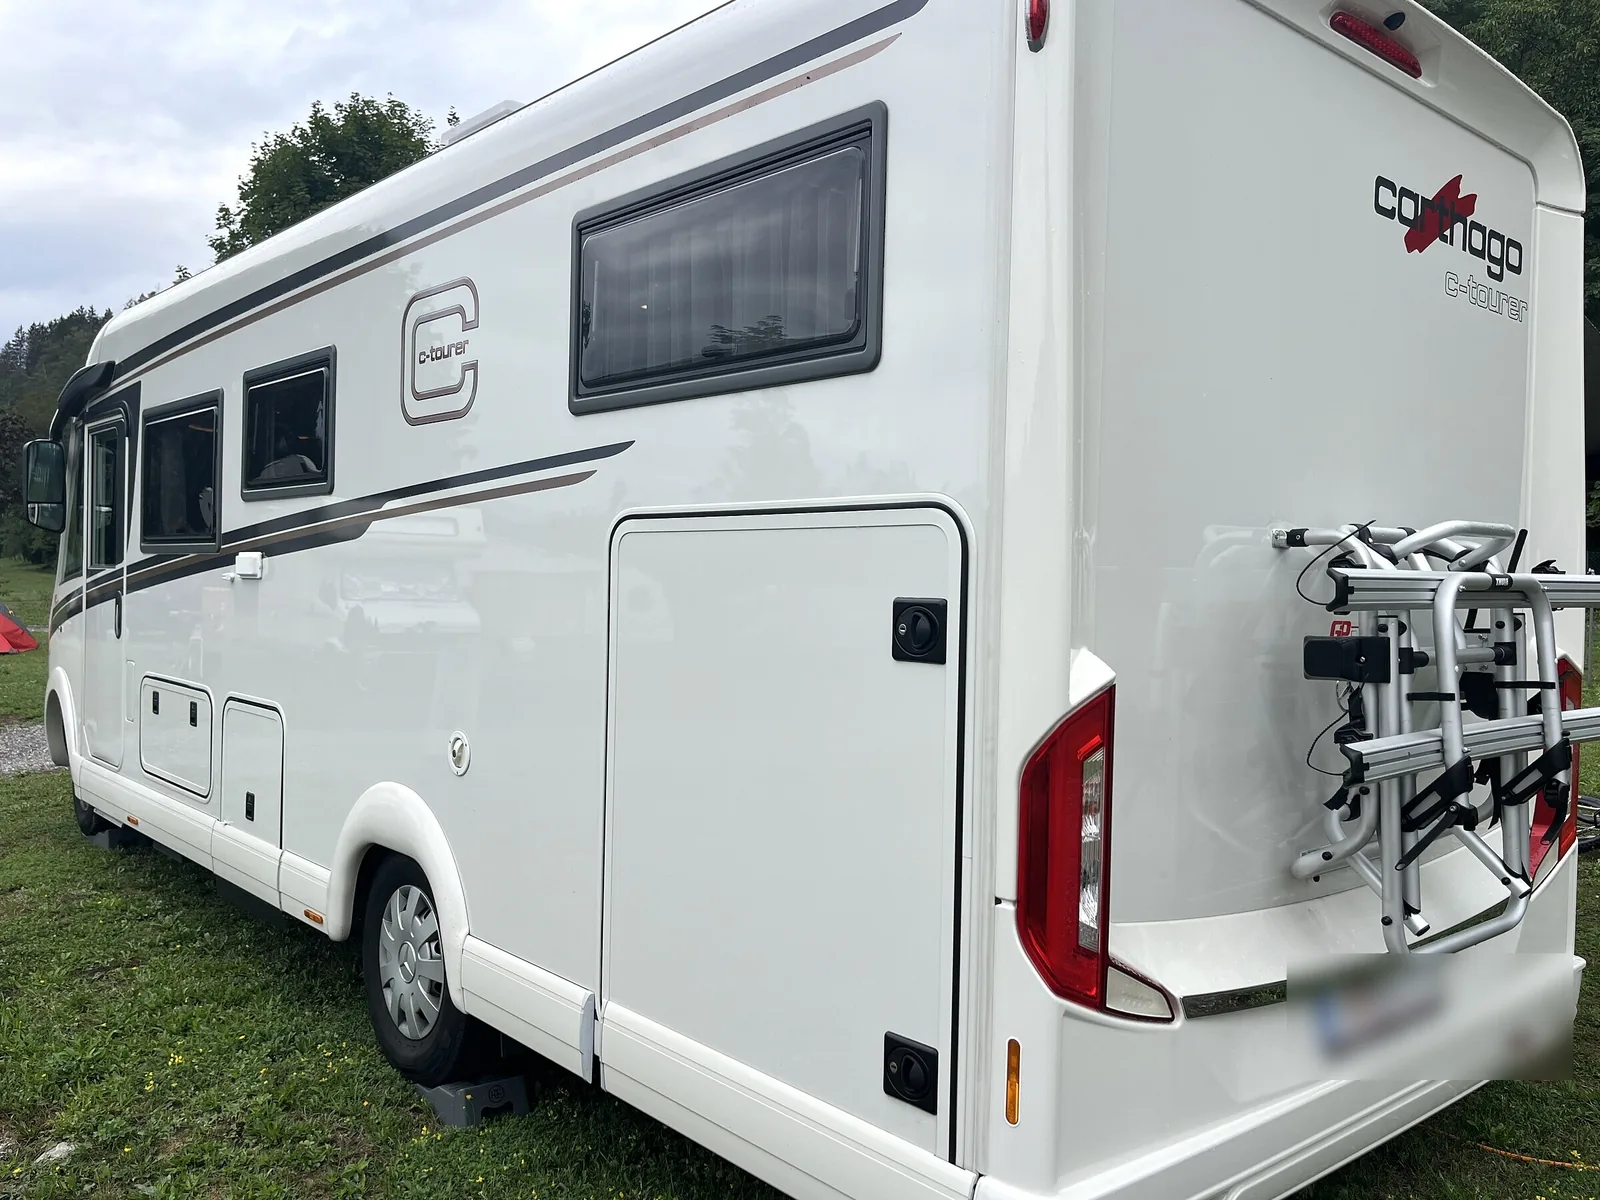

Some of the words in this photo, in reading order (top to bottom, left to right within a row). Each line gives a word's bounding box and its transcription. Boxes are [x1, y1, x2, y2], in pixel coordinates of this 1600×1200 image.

[1374, 175, 1523, 283] carthago
[1445, 271, 1528, 322] c-tourer
[418, 339, 469, 365] c-tourer
